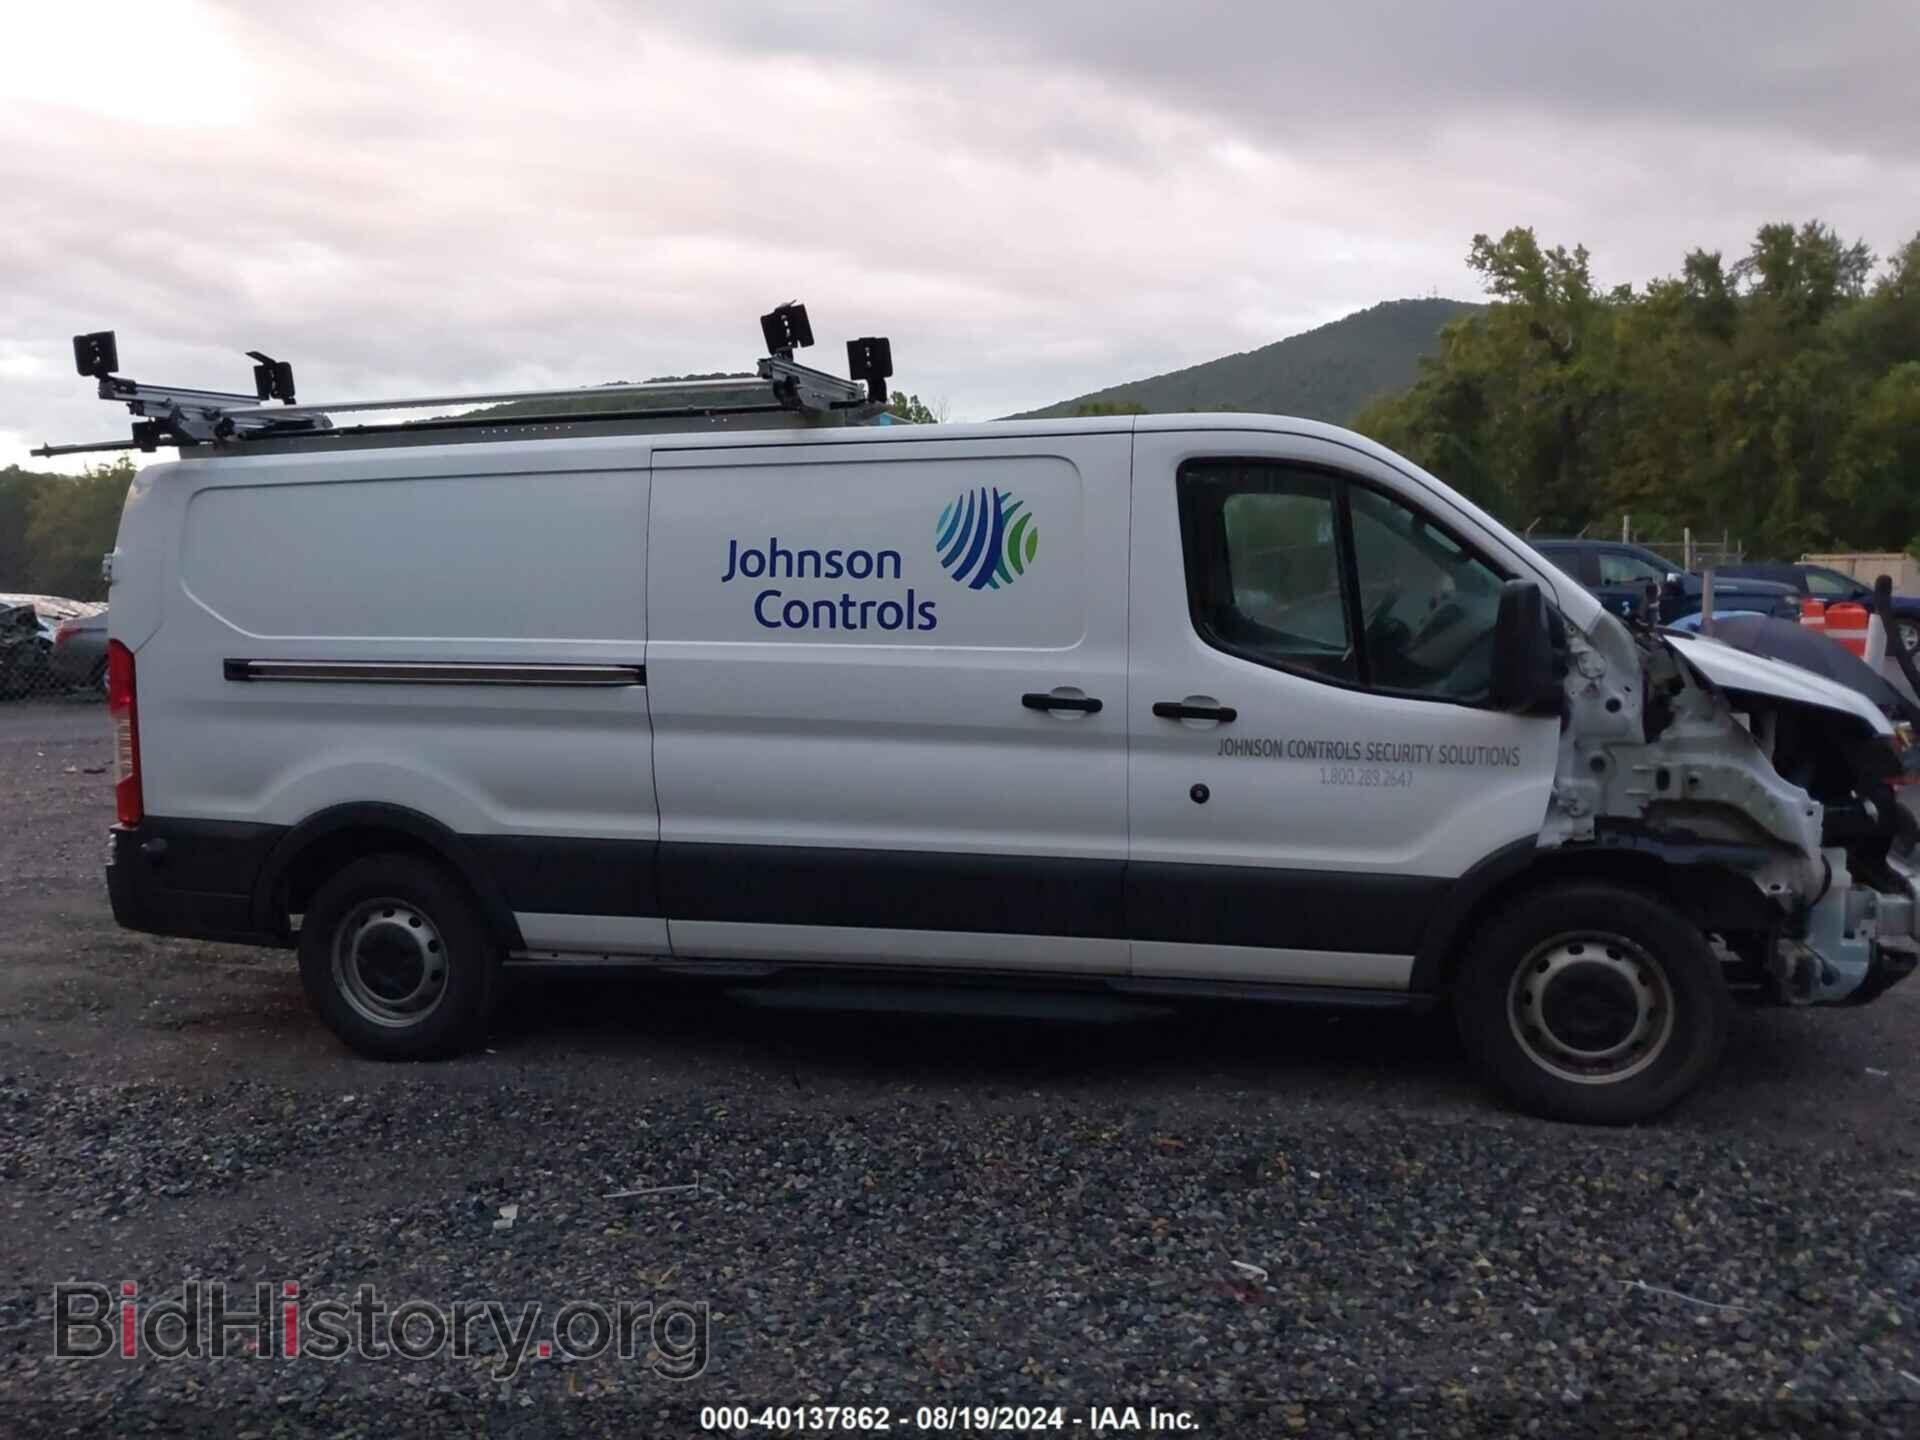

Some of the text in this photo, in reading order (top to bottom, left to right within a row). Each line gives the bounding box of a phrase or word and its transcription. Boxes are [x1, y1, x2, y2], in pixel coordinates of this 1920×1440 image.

[721, 537, 901, 583] Johnson
[754, 588, 938, 631] Controls
[1216, 737, 1521, 768] JOHNSON CONTROLS SECURITY SOLUTIONS
